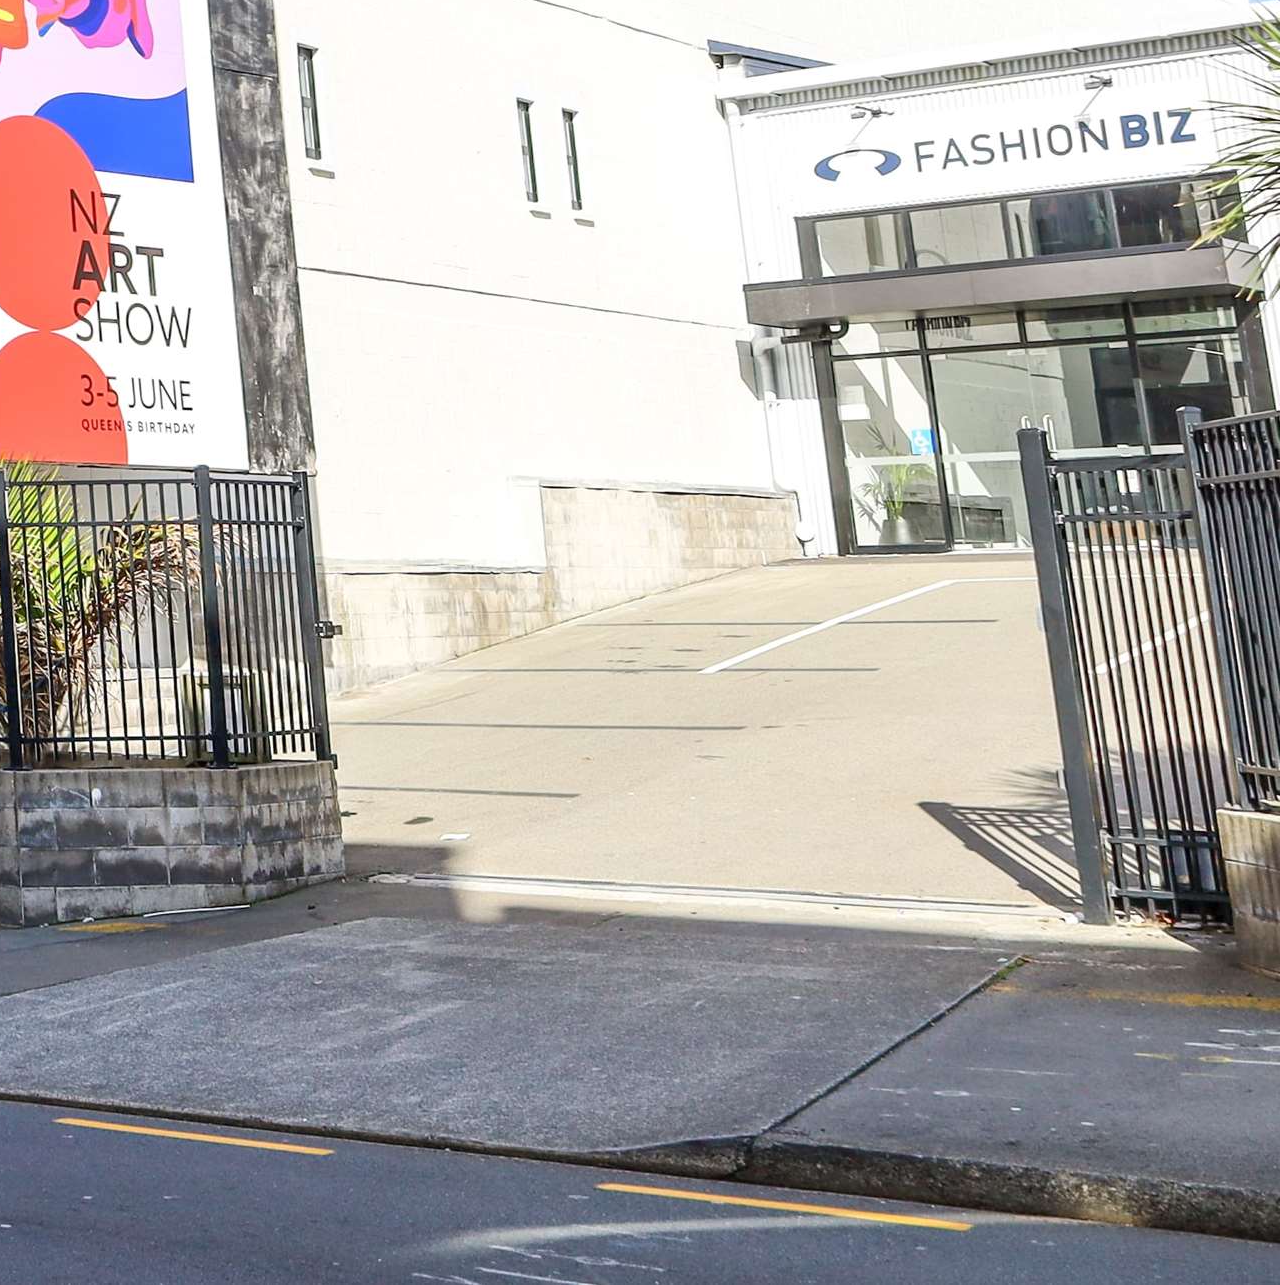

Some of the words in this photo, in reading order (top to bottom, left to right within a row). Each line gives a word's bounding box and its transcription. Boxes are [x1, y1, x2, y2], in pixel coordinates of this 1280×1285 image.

[913, 118, 1109, 173] FASHION
[1121, 110, 1196, 150] BIZ
[69, 188, 125, 237] NZ
[72, 240, 165, 297] ART
[73, 297, 192, 348] SHOW
[80, 374, 119, 408] 3-5
[128, 377, 194, 411] JUNE
[137, 421, 196, 435] BIRTHDAY
